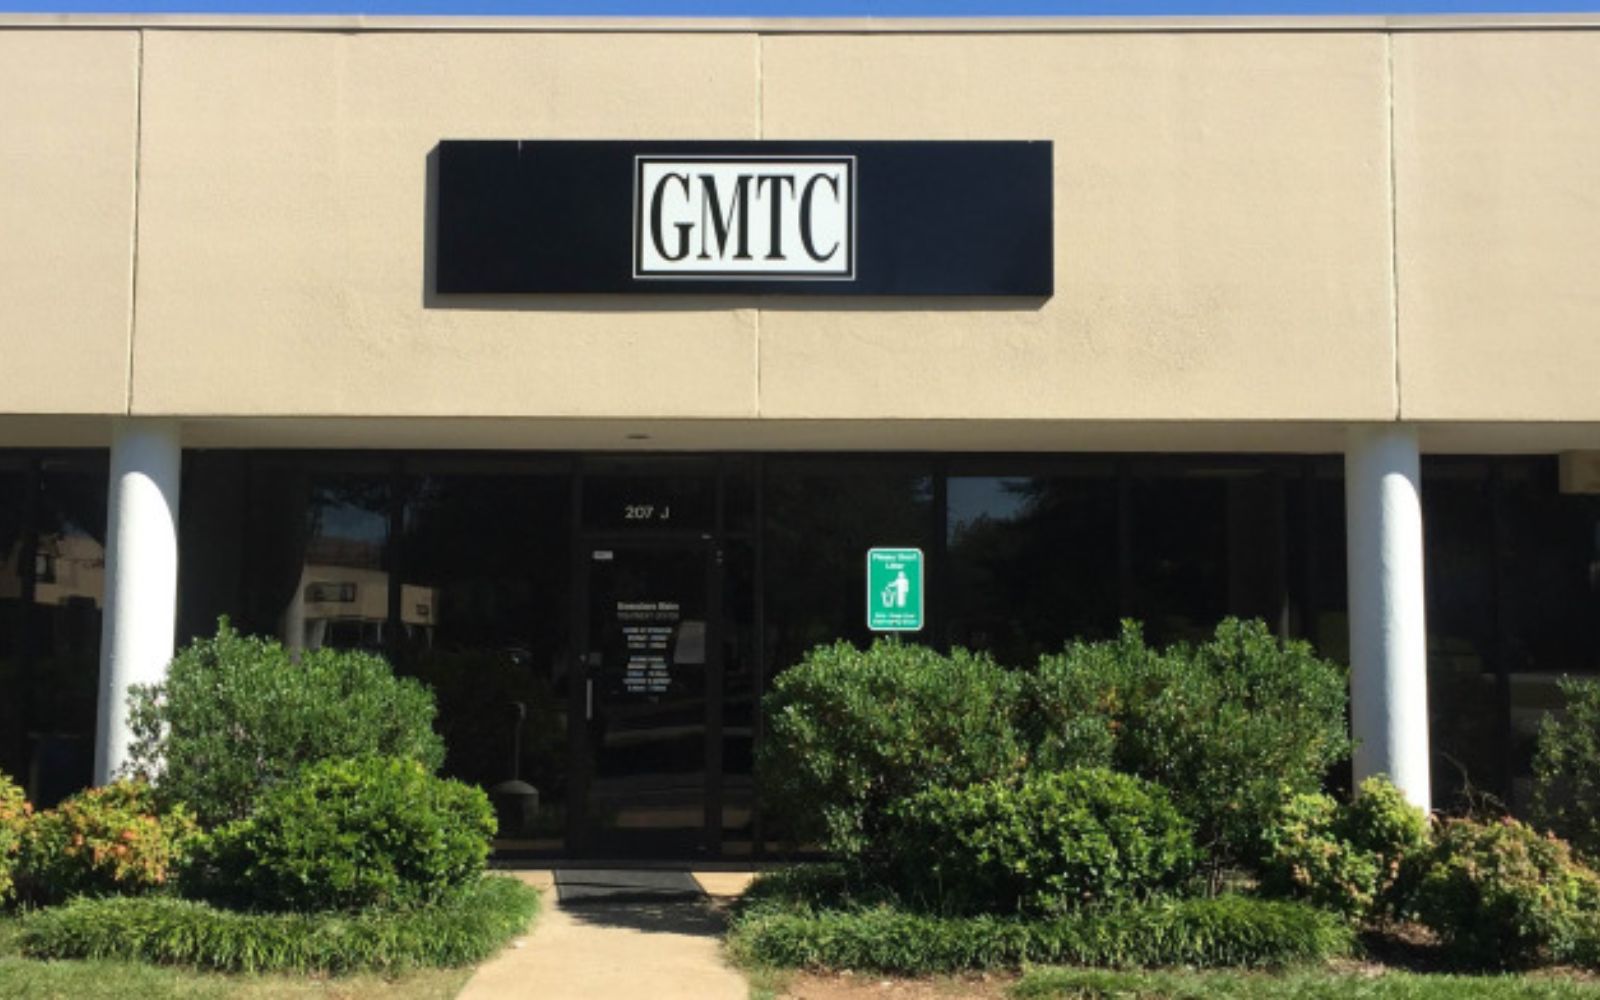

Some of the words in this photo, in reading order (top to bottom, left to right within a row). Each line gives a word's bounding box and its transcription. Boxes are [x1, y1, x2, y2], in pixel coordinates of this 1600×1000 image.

[650, 172, 840, 263] GMTC
[624, 504, 655, 519] 207
[660, 505, 670, 519] J
